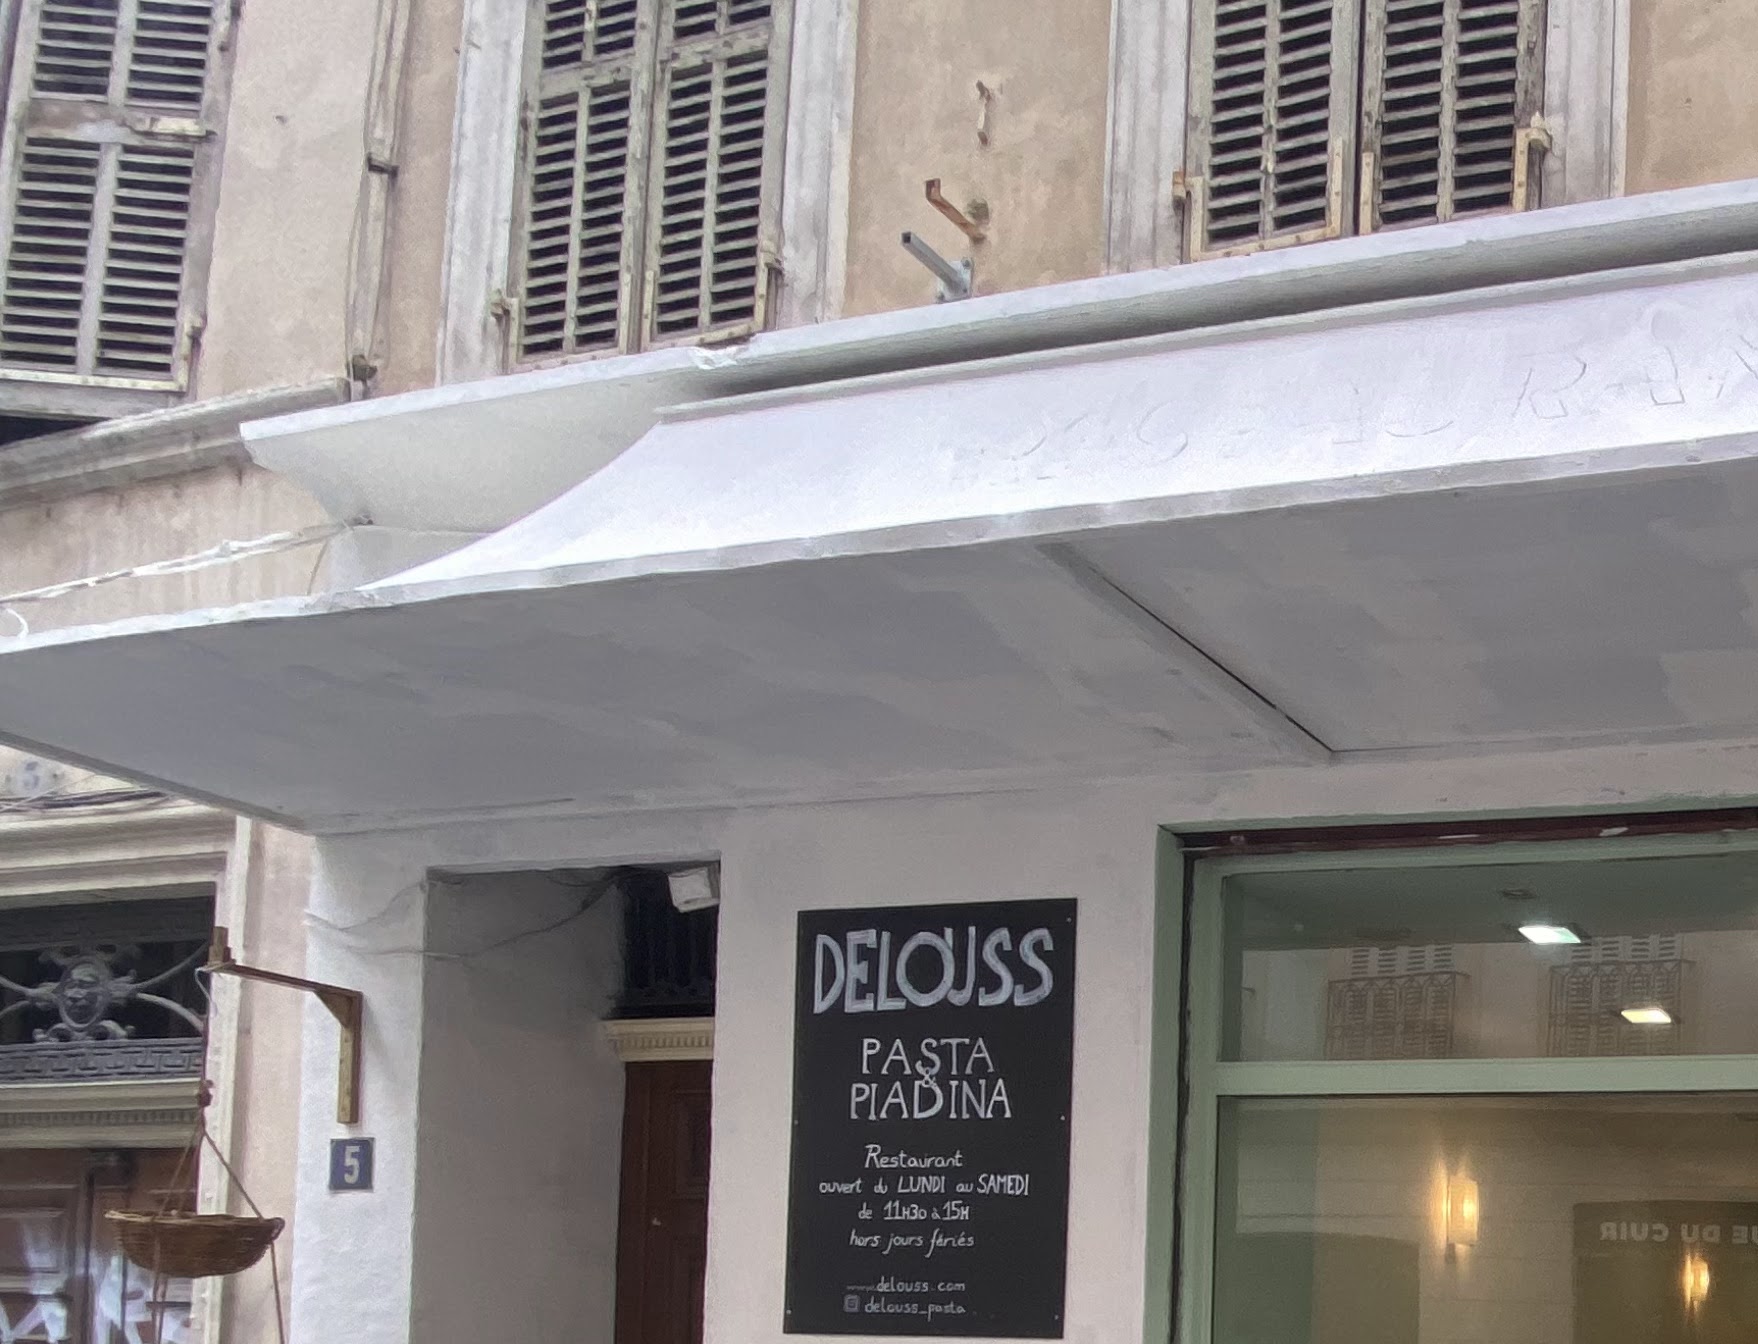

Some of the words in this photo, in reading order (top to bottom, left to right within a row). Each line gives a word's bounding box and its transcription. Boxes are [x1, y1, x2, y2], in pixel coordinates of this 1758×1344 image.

[813, 926, 1054, 1014] DELOUSS
[862, 1037, 994, 1076] PASTA
[921, 1067, 937, 1088] &
[850, 1078, 1012, 1120] PIADINA
[344, 1146, 360, 1184] 5
[864, 1144, 963, 1168] Restaurant
[819, 1177, 862, 1194] ouvert
[874, 1176, 888, 1194] du
[898, 1176, 946, 1194] LUNDI
[956, 1181, 974, 1193] au
[977, 1174, 1030, 1196] SAMEDI
[858, 1202, 873, 1220] de
[931, 1207, 941, 1220] à
[942, 1200, 970, 1220] 15H
[850, 1230, 881, 1248] hors
[881, 1232, 923, 1255] jours
[924, 1228, 975, 1258] fériés
[864, 1296, 966, 1322] delouss_pasta
